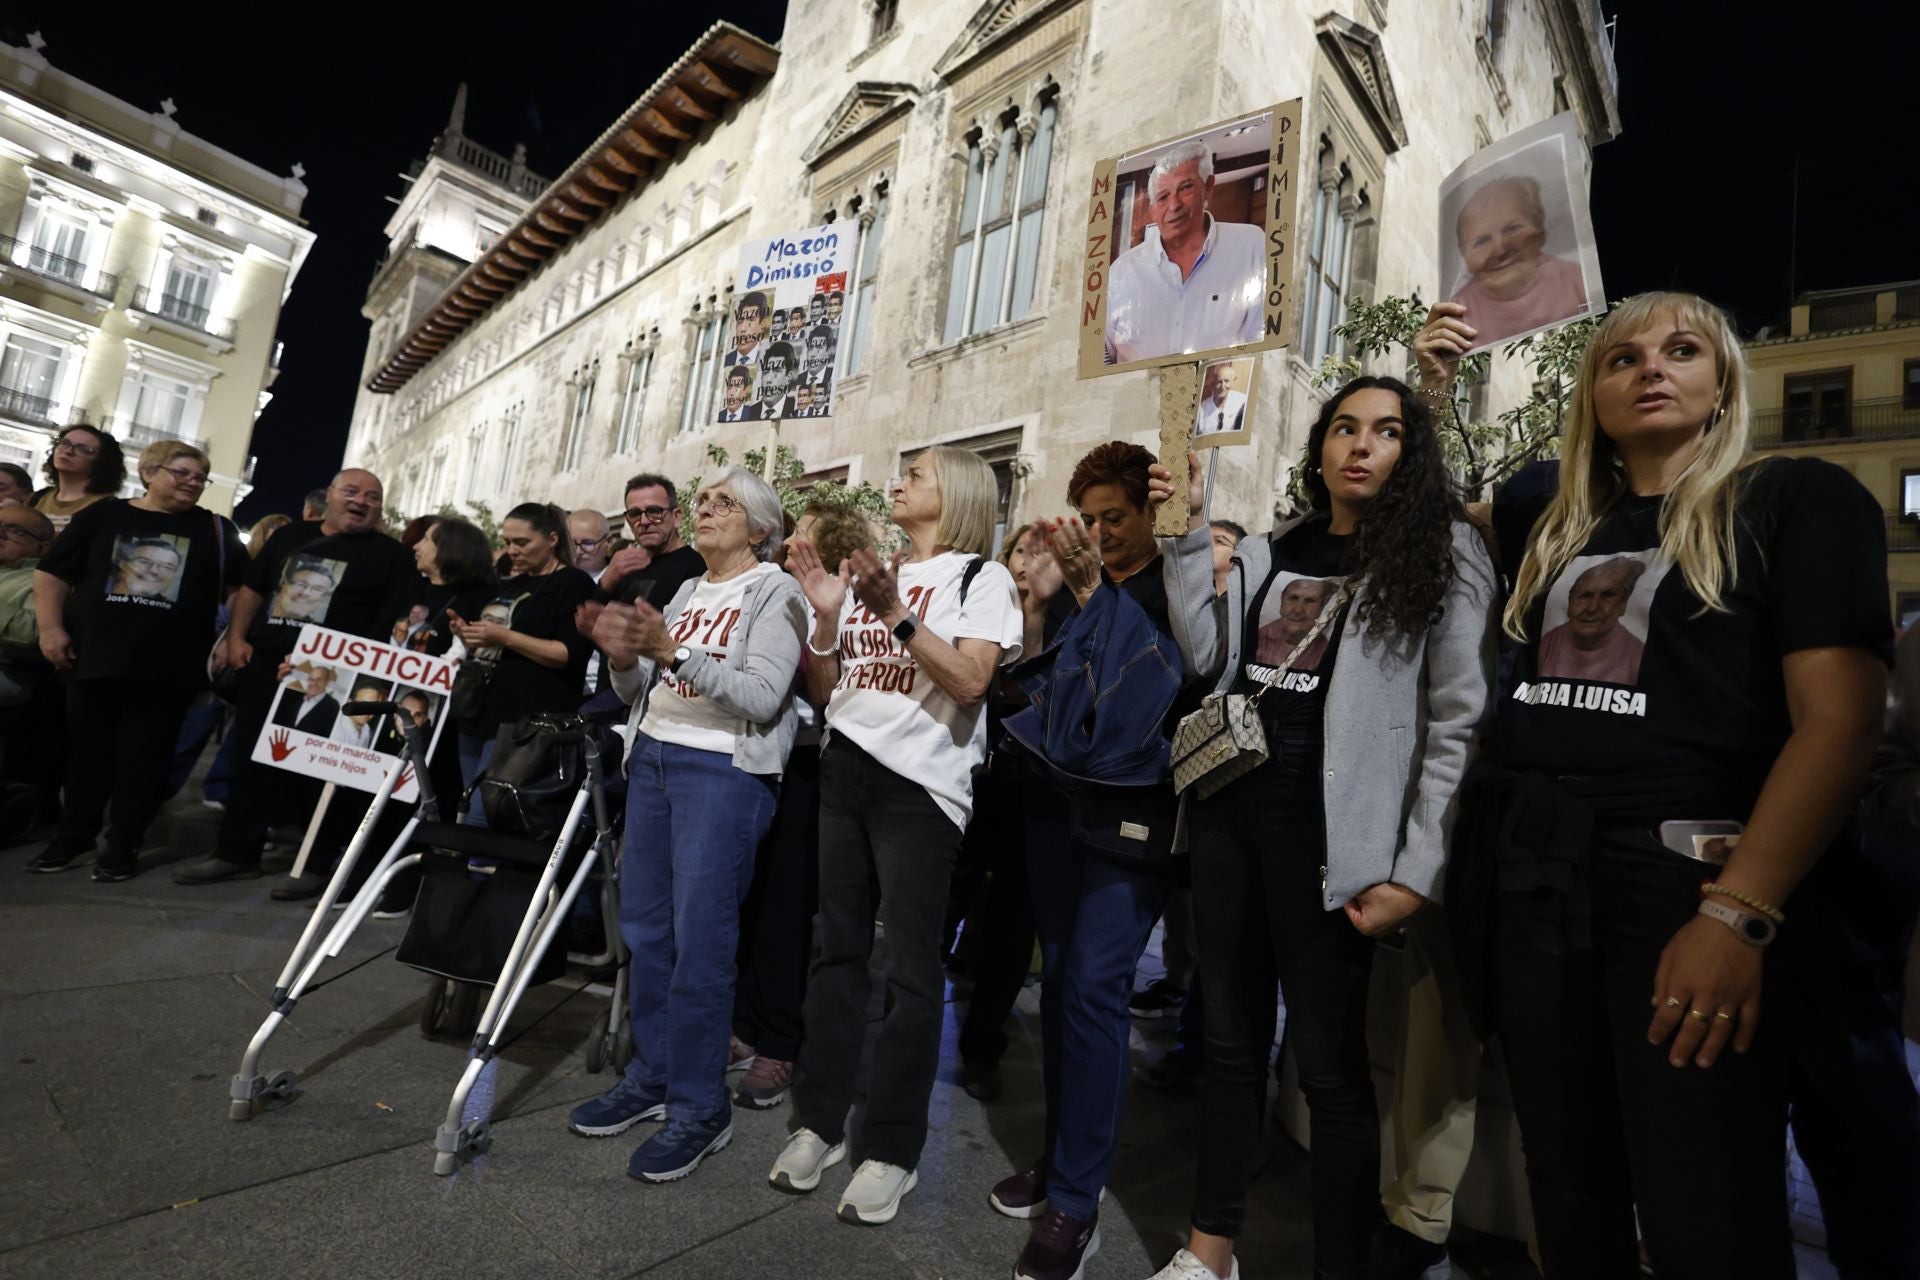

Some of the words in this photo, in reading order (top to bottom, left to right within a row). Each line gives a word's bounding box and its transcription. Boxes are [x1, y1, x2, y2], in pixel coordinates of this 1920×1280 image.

[765, 225, 838, 262] Mazón
[1083, 173, 1110, 327] MAZÓN
[746, 251, 836, 289] Dimissió
[105, 592, 129, 603] José
[132, 595, 172, 610] Vicente
[301, 632, 451, 690] JUSTICIA
[1573, 685, 1646, 717] LUISA
[305, 737, 325, 747] por
[327, 742, 340, 752] mi
[343, 746, 381, 763] marido
[309, 753, 317, 763] y
[319, 756, 337, 767] mis
[341, 760, 366, 774] hijos
